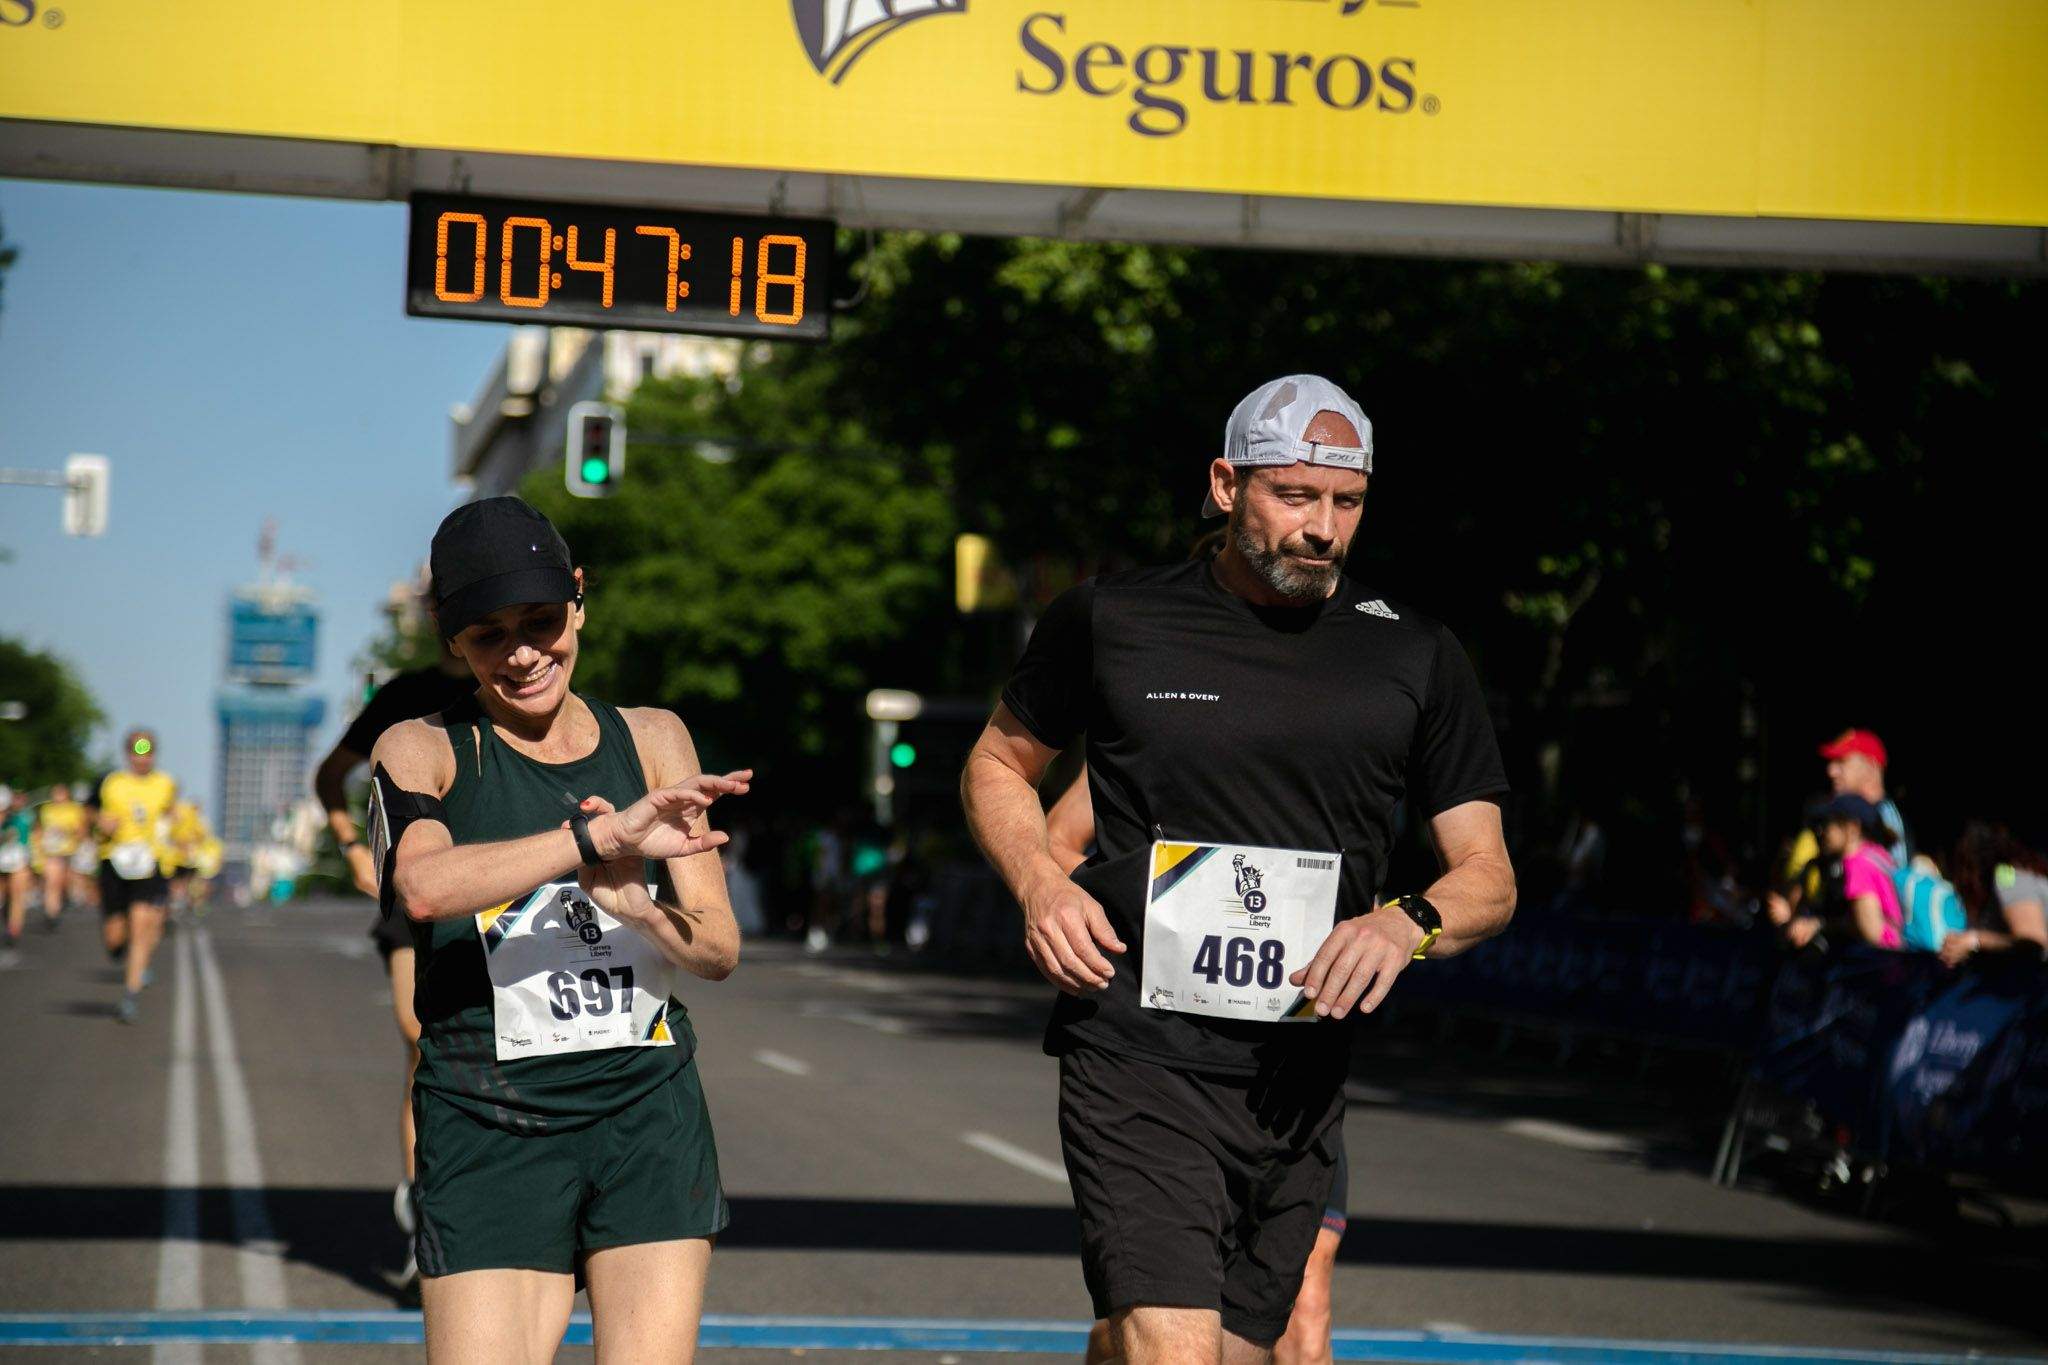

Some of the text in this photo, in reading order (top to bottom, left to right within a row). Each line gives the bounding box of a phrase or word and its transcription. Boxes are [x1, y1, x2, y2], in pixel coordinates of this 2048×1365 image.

[1189, 693, 1220, 702] OVERY
[1248, 895, 1262, 908] 13
[1249, 913, 1271, 921] Carrera
[1249, 920, 1271, 929] Liberty
[584, 928, 597, 940] 13
[1192, 934, 1286, 990] 468
[546, 965, 634, 1021] 697
